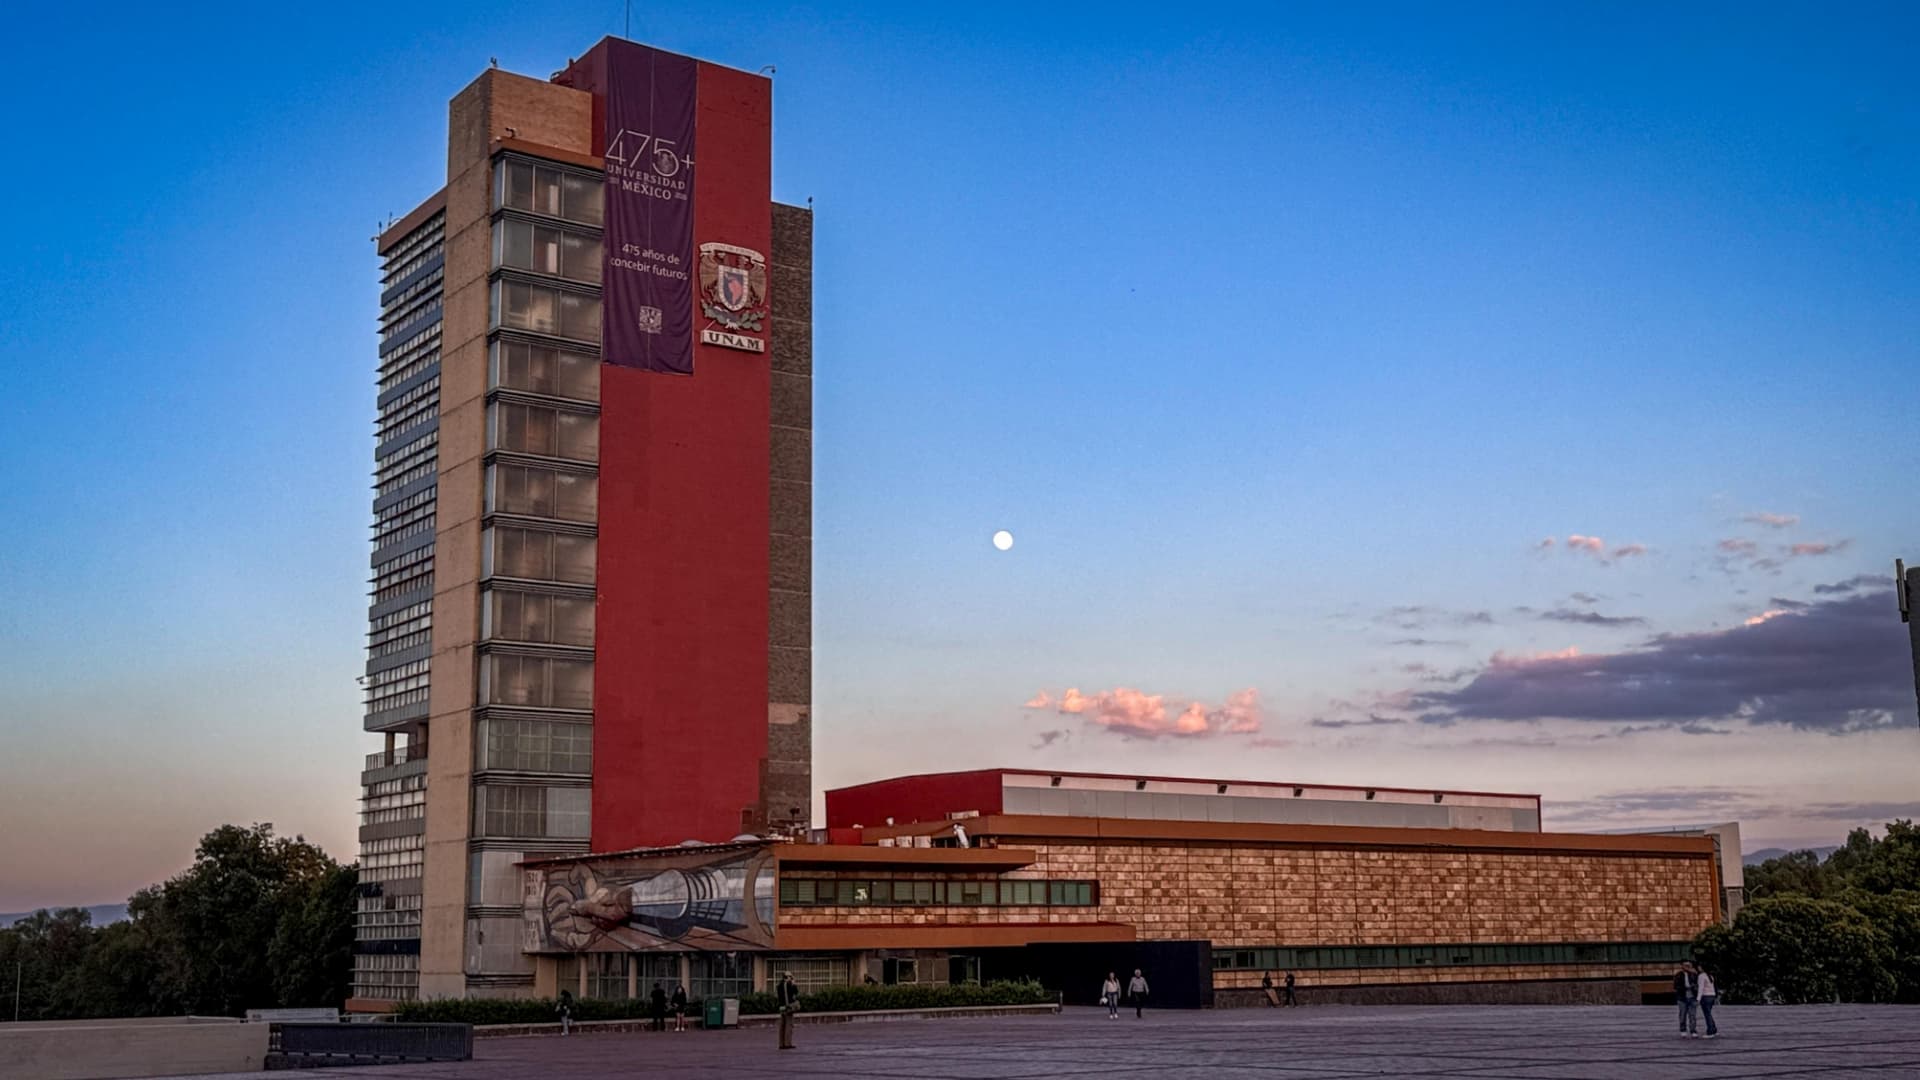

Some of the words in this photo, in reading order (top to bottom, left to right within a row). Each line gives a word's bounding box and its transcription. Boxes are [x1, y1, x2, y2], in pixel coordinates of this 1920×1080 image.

[607, 164, 685, 190] UNIVERSIDAD
[622, 243, 640, 256] 475
[642, 249, 665, 262] años
[667, 254, 680, 265] de
[610, 257, 650, 273] concebir
[652, 264, 688, 281] futuros
[708, 332, 760, 350] UNAM
